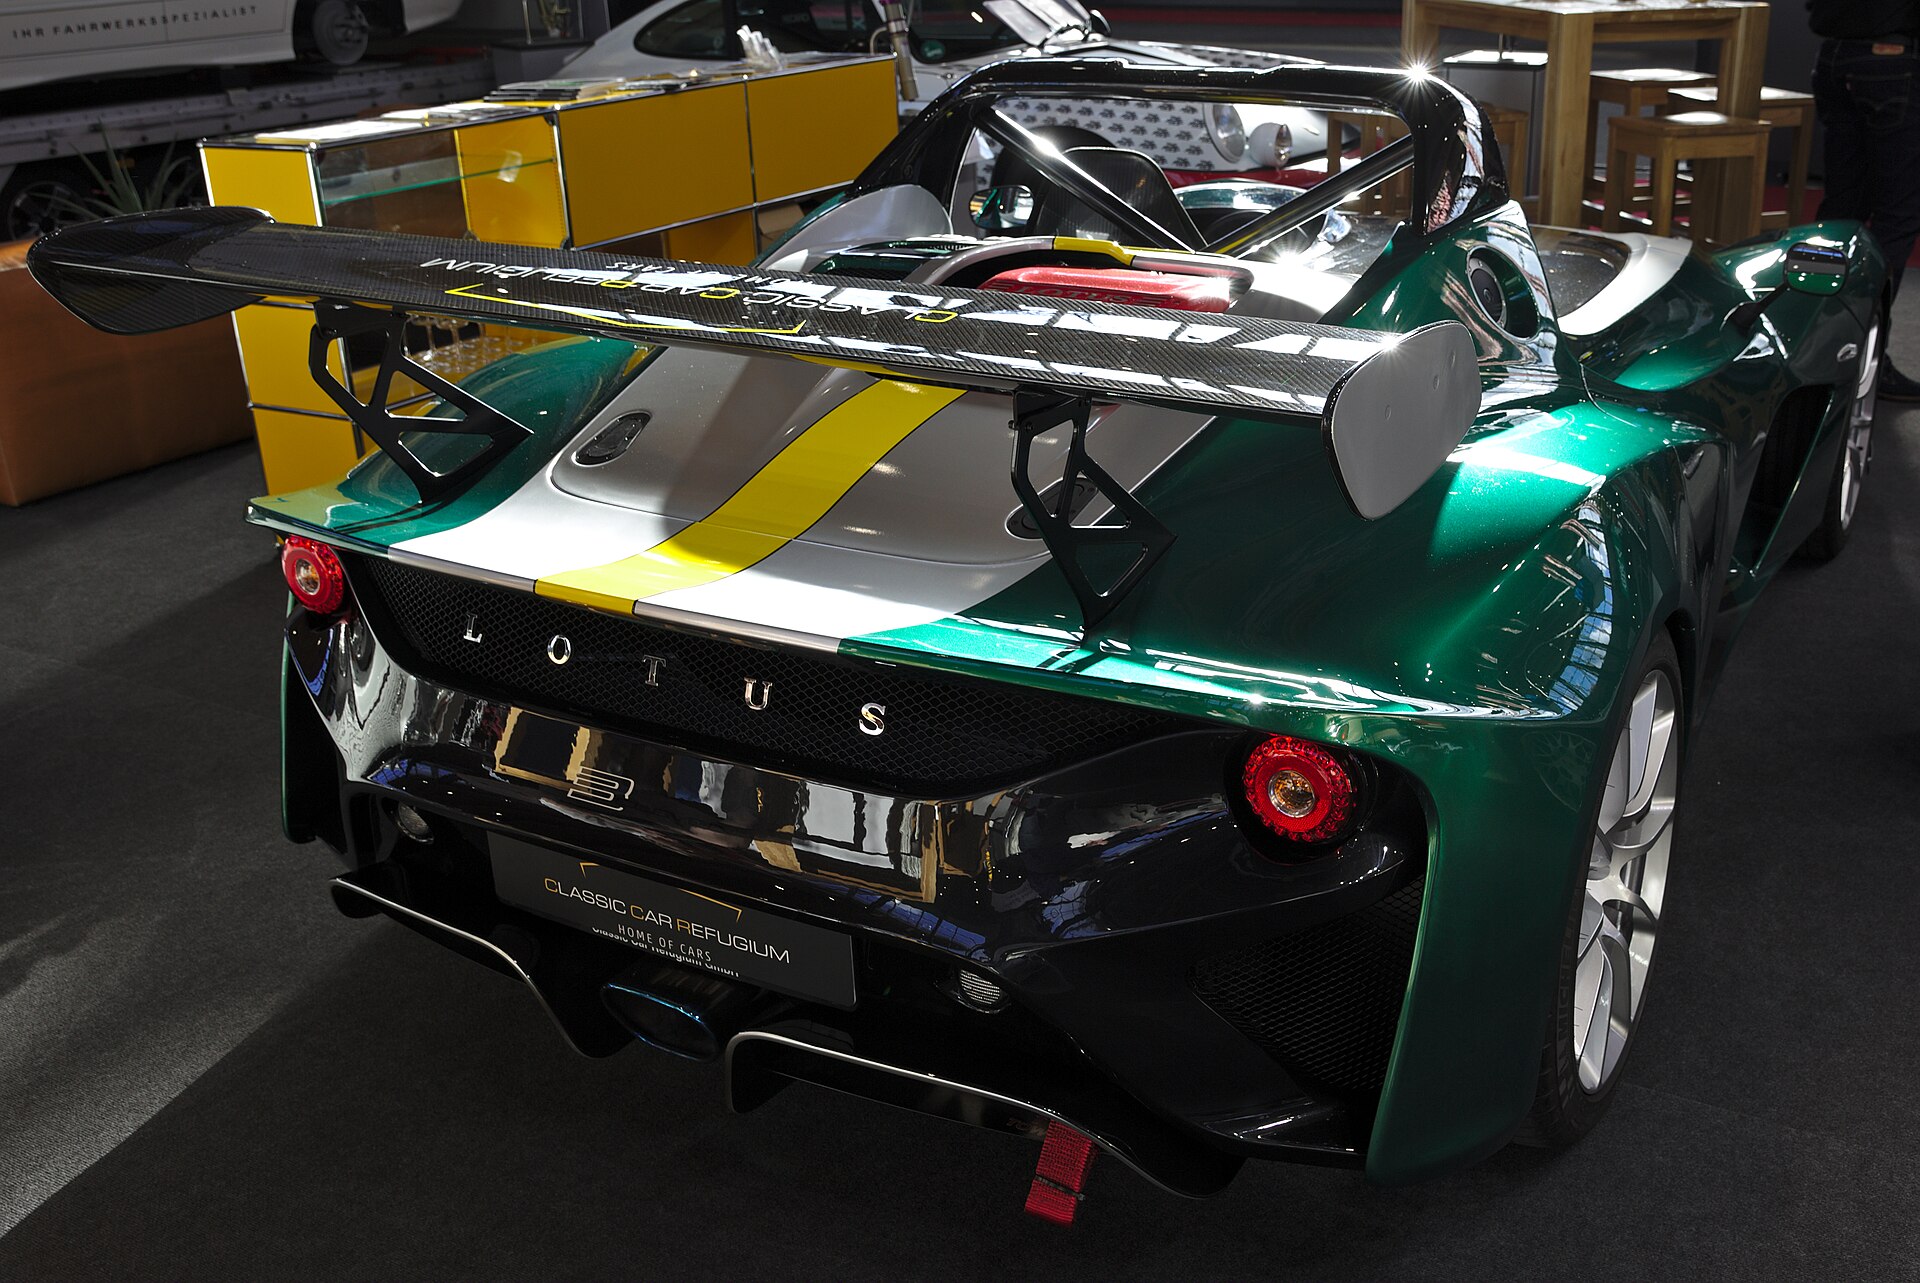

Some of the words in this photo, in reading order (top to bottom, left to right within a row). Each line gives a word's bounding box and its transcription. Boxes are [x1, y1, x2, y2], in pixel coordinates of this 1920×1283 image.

[12, 28, 46, 40] IHR
[52, 5, 258, 37] FAHRWERKSSPEZIALIST
[1016, 286, 1133, 303] LOTUS
[463, 613, 887, 736] LOTUS
[544, 878, 627, 915] CLASSIC
[630, 904, 673, 929] CAR
[676, 918, 790, 964] REFUGIUM
[617, 923, 653, 944] HOME
[658, 936, 675, 949] OF
[680, 943, 713, 962] CARS
